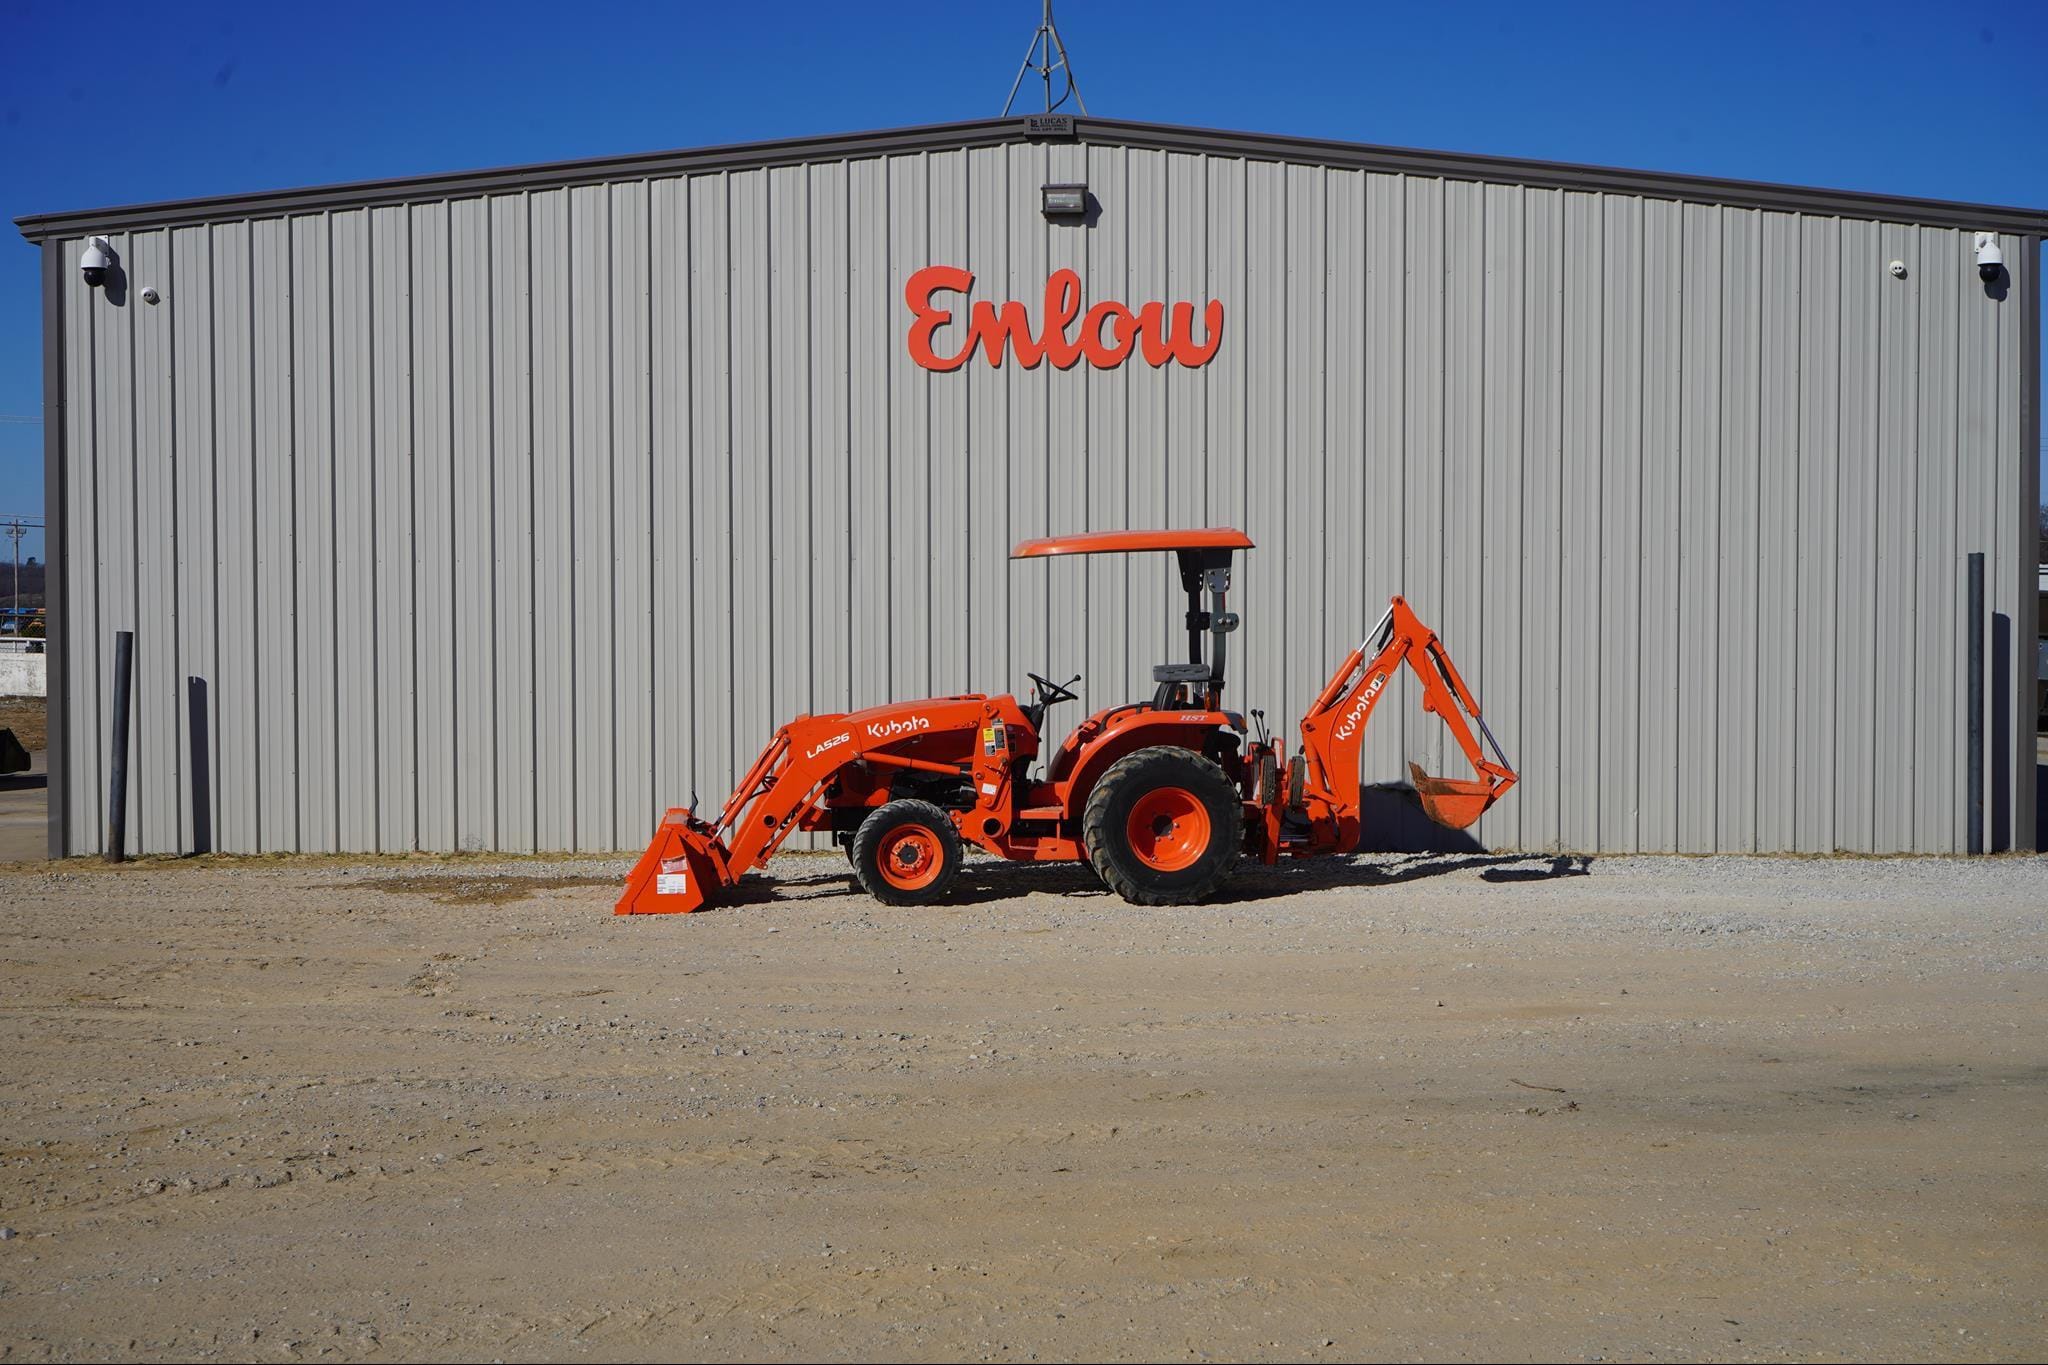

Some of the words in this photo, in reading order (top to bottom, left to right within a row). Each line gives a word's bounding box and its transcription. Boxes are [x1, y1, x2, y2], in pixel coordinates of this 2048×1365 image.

[867, 716, 930, 737] Kubota
[1335, 689, 1376, 740] Kubota
[806, 732, 850, 759] LA526
